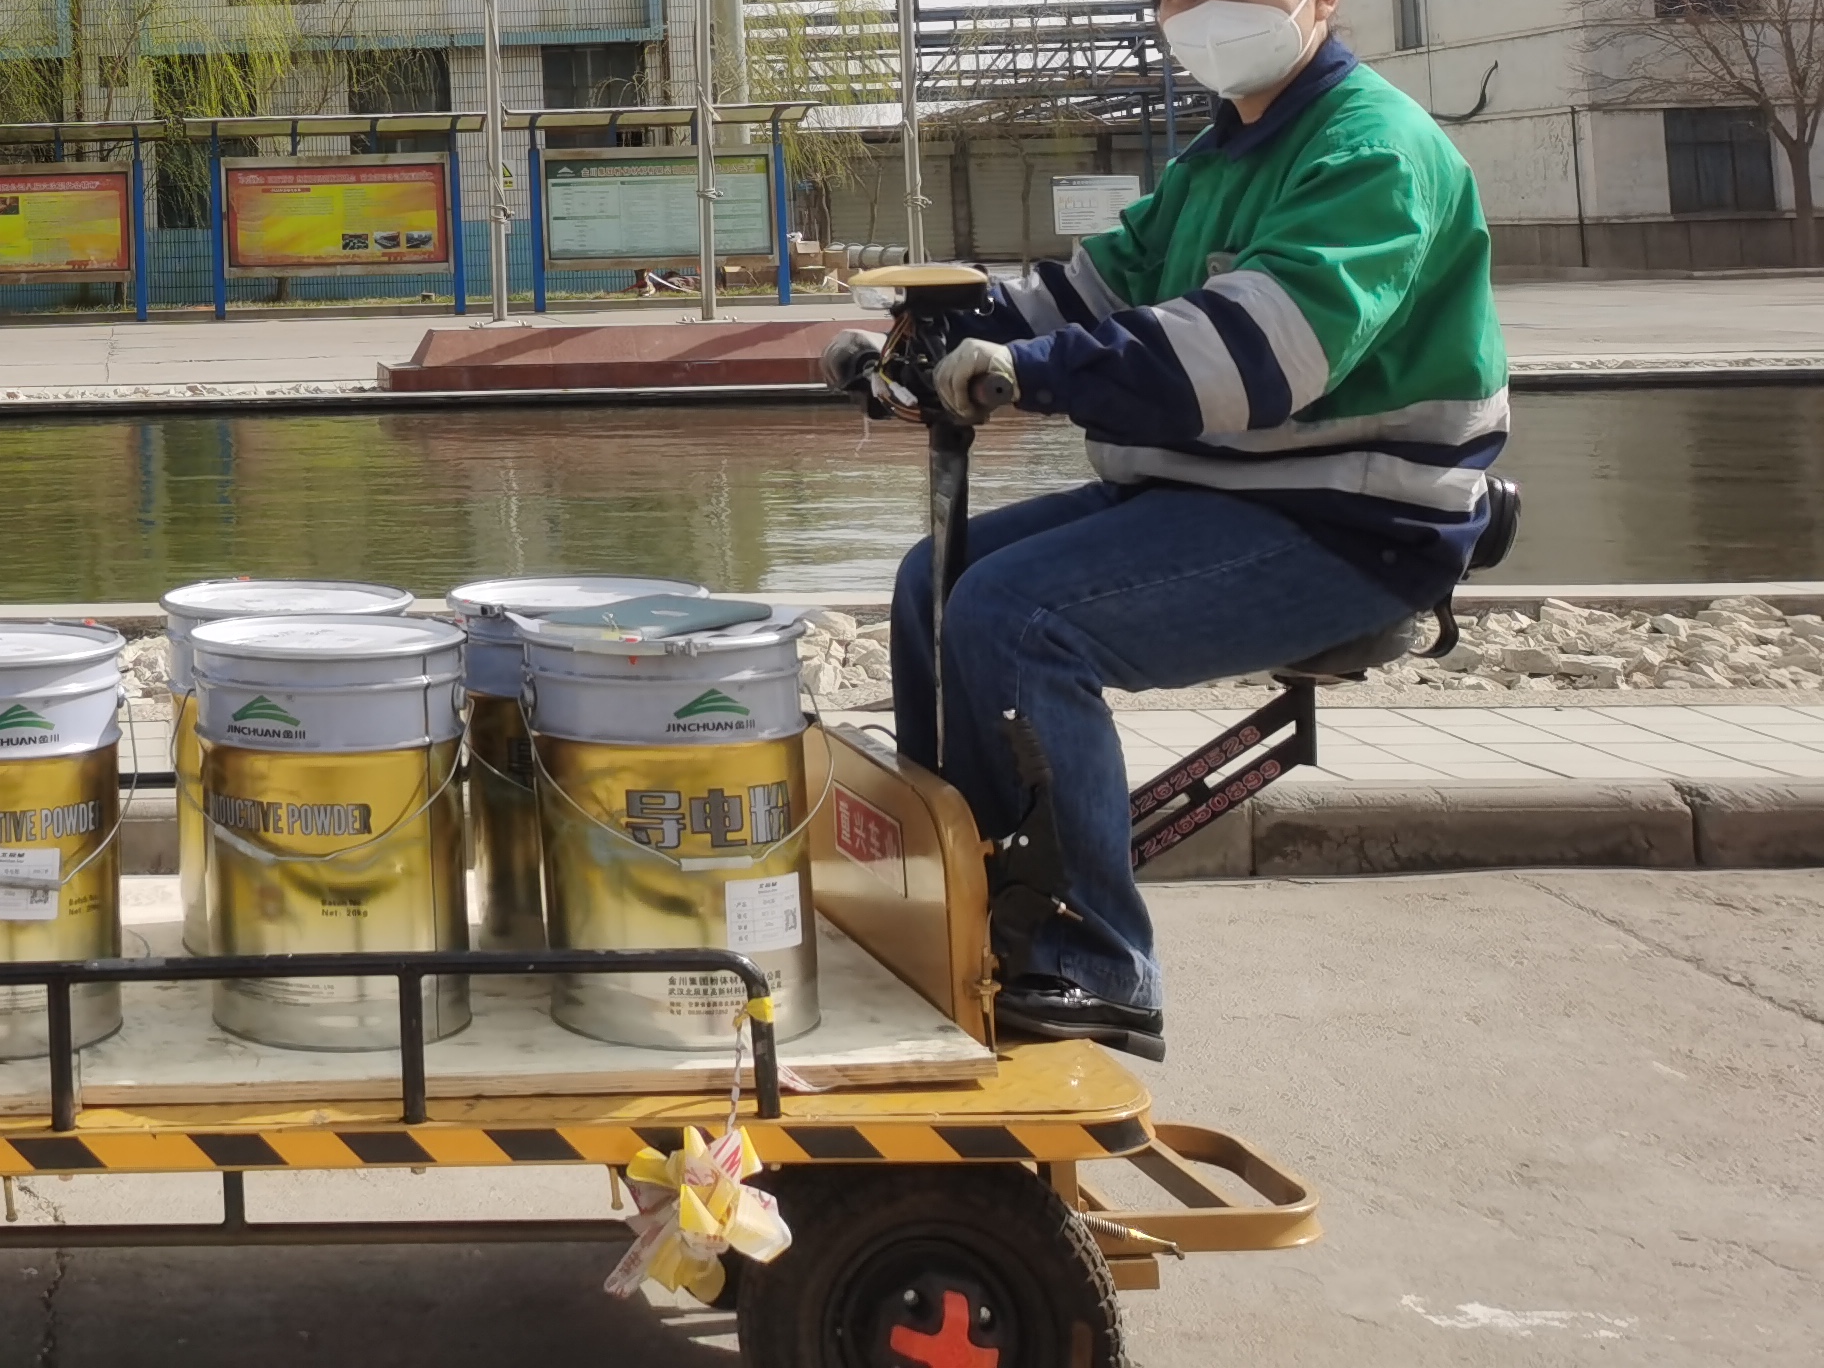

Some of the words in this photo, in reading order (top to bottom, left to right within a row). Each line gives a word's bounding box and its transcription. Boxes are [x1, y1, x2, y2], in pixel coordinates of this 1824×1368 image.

[286, 802, 373, 836] POWDER
[625, 780, 792, 849] 导电粉
